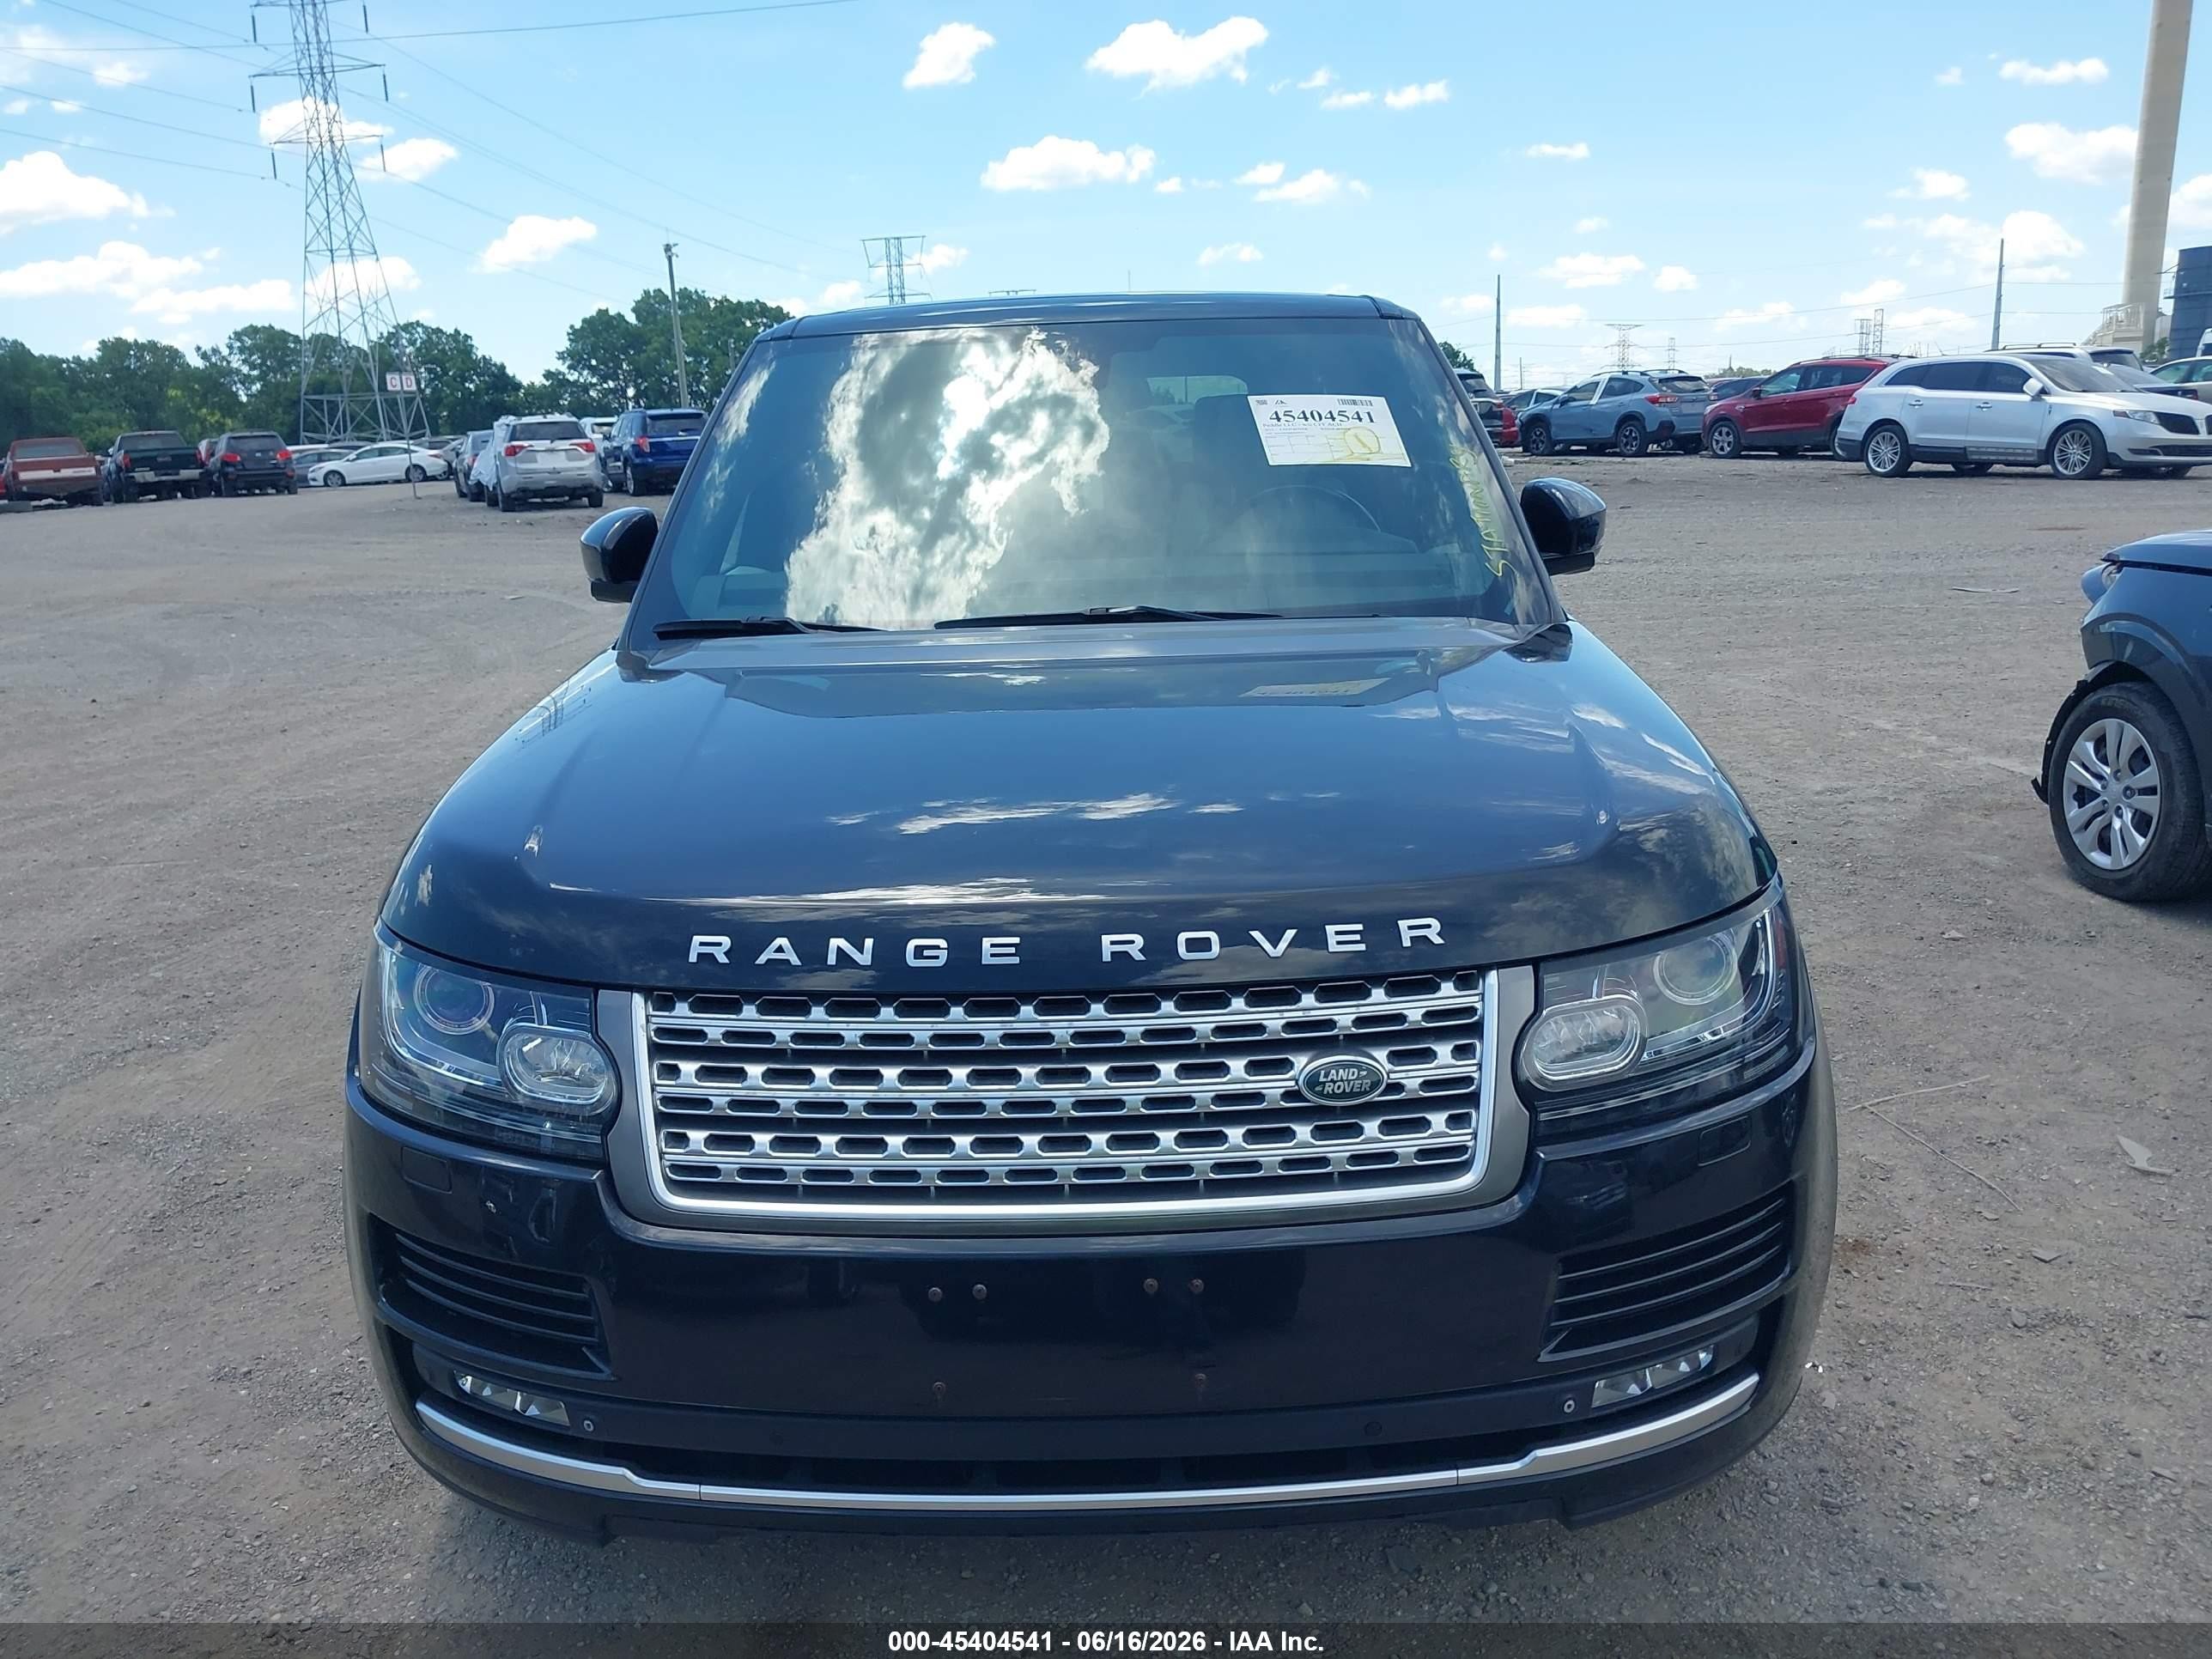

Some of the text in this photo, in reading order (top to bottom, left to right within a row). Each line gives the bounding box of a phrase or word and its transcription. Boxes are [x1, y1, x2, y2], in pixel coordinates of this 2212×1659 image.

[390, 376, 397, 387] C
[405, 377, 412, 387] D
[1269, 410, 1376, 423] 45404541
[689, 917, 1445, 968] RANGE ROVER
[1319, 1068, 1358, 1082] LAND
[1323, 1079, 1371, 1094] ROVER
